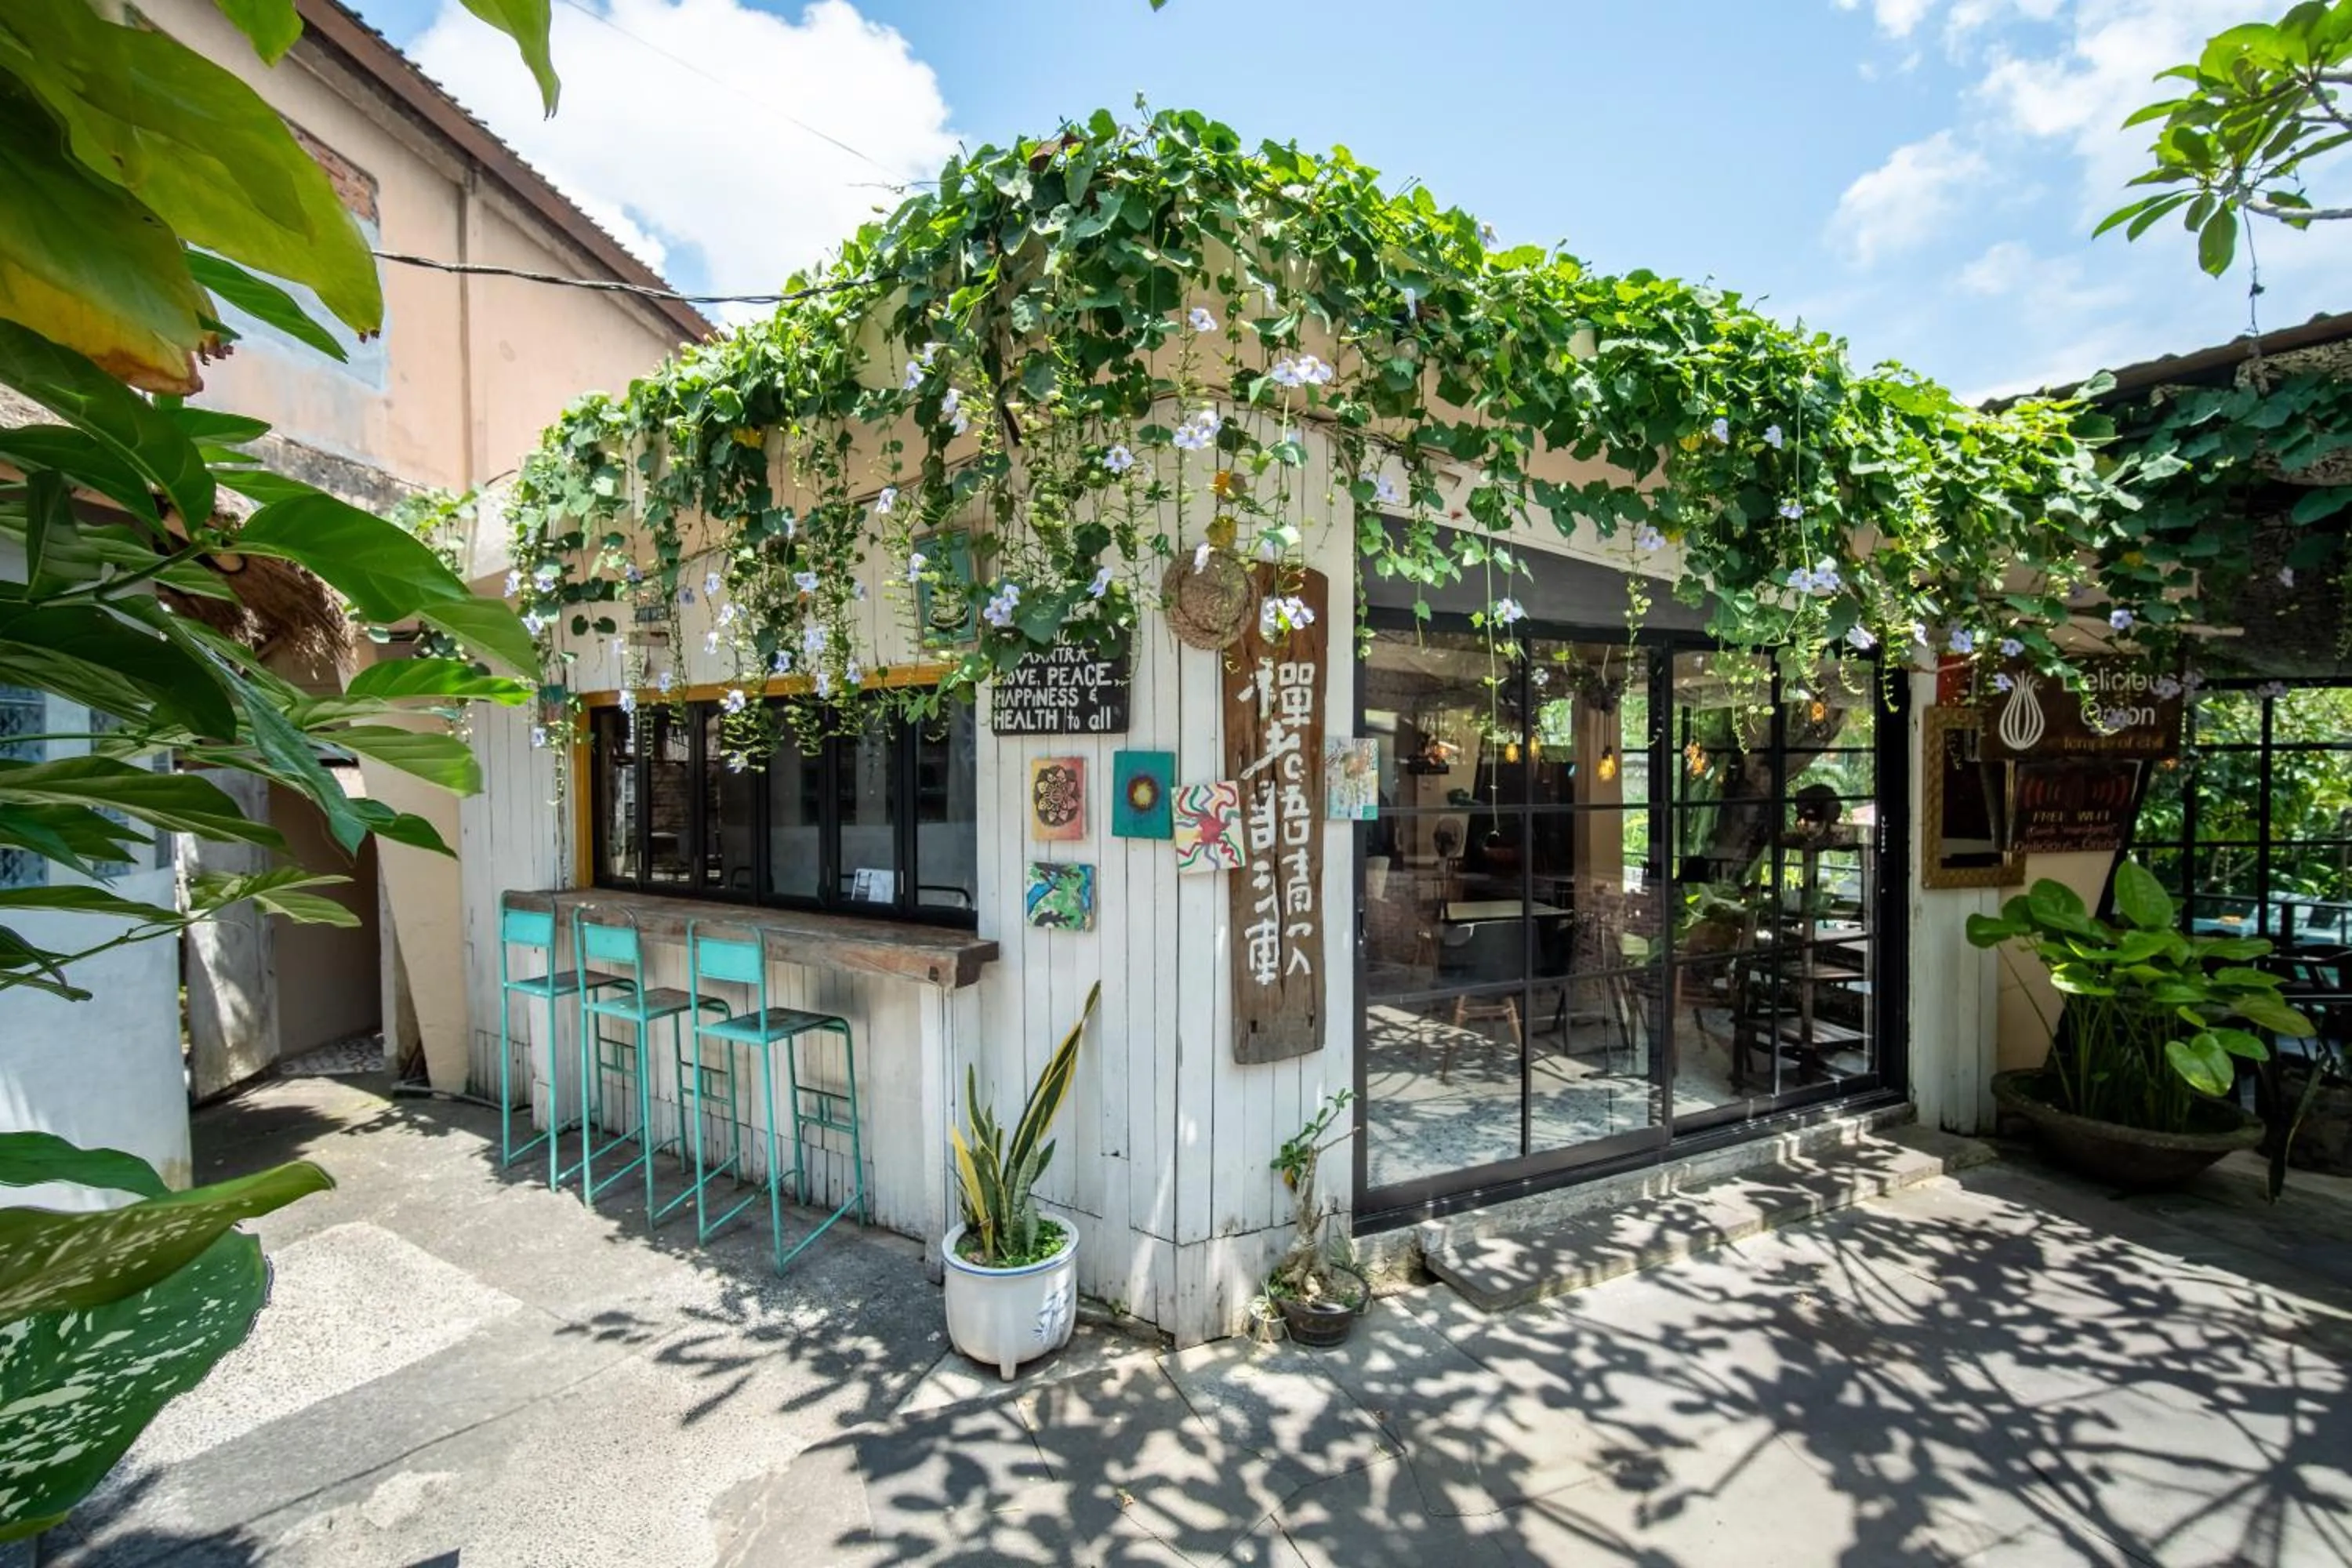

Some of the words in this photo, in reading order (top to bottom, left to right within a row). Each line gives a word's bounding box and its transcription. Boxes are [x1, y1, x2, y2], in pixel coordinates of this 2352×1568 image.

[996, 667, 1040, 687] OVE,
[993, 707, 1058, 731] HEALTH
[1067, 708, 1081, 730] to
[1088, 706, 1112, 731] all
